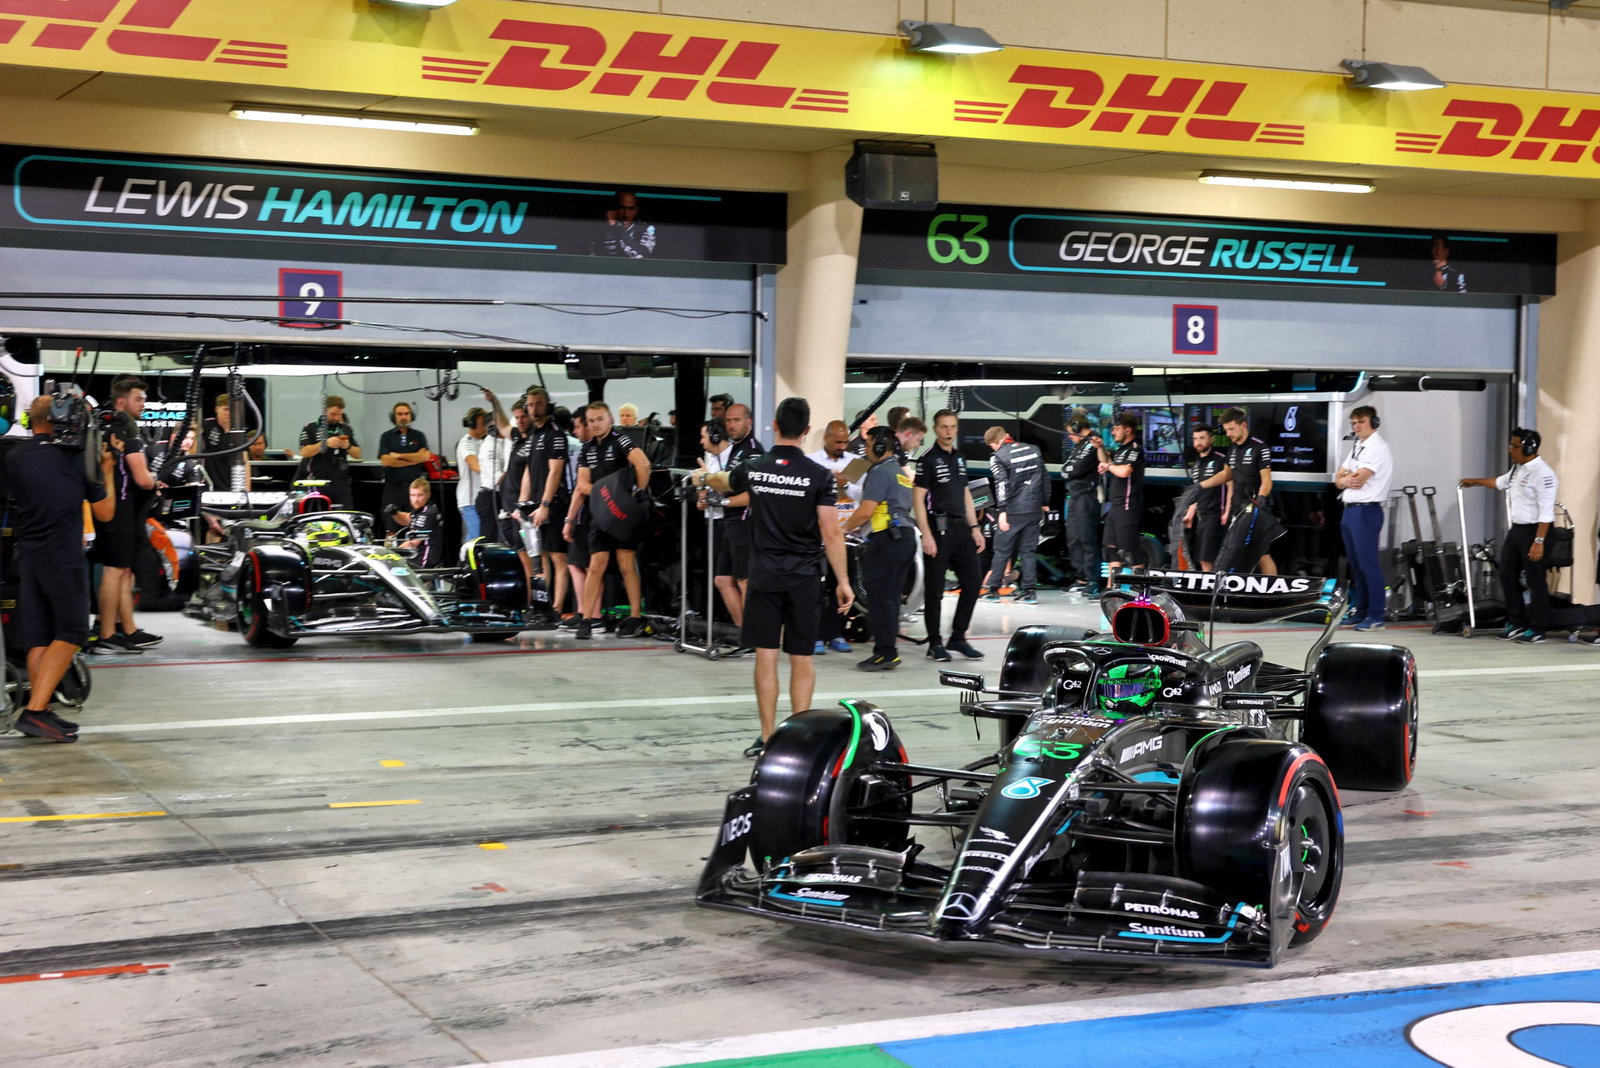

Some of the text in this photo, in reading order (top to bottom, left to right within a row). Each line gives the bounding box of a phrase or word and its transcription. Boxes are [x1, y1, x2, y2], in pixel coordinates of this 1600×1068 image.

[0, 0, 223, 61] HL
[484, 19, 796, 108] DHL
[1003, 64, 1261, 142] DHL
[1437, 99, 1600, 163] DH
[84, 176, 528, 235] LEWIS HAMILTON
[927, 214, 990, 265] 63
[1058, 231, 1359, 274] GEORGE RUSSELL
[299, 282, 324, 316] 9
[1186, 315, 1206, 345] 8
[748, 471, 811, 487] PETRONAS
[752, 485, 806, 497] CROWDSTRIKE
[1063, 679, 1082, 690] G42
[1163, 687, 1182, 698] G42
[1014, 740, 1084, 760] 63
[1131, 736, 1163, 759] AMG
[721, 812, 753, 846] INEOS
[804, 873, 862, 883] PETRONAS
[789, 888, 850, 900] Syntium
[1124, 902, 1199, 919] PETRONAS
[1129, 922, 1205, 938] Syntium
